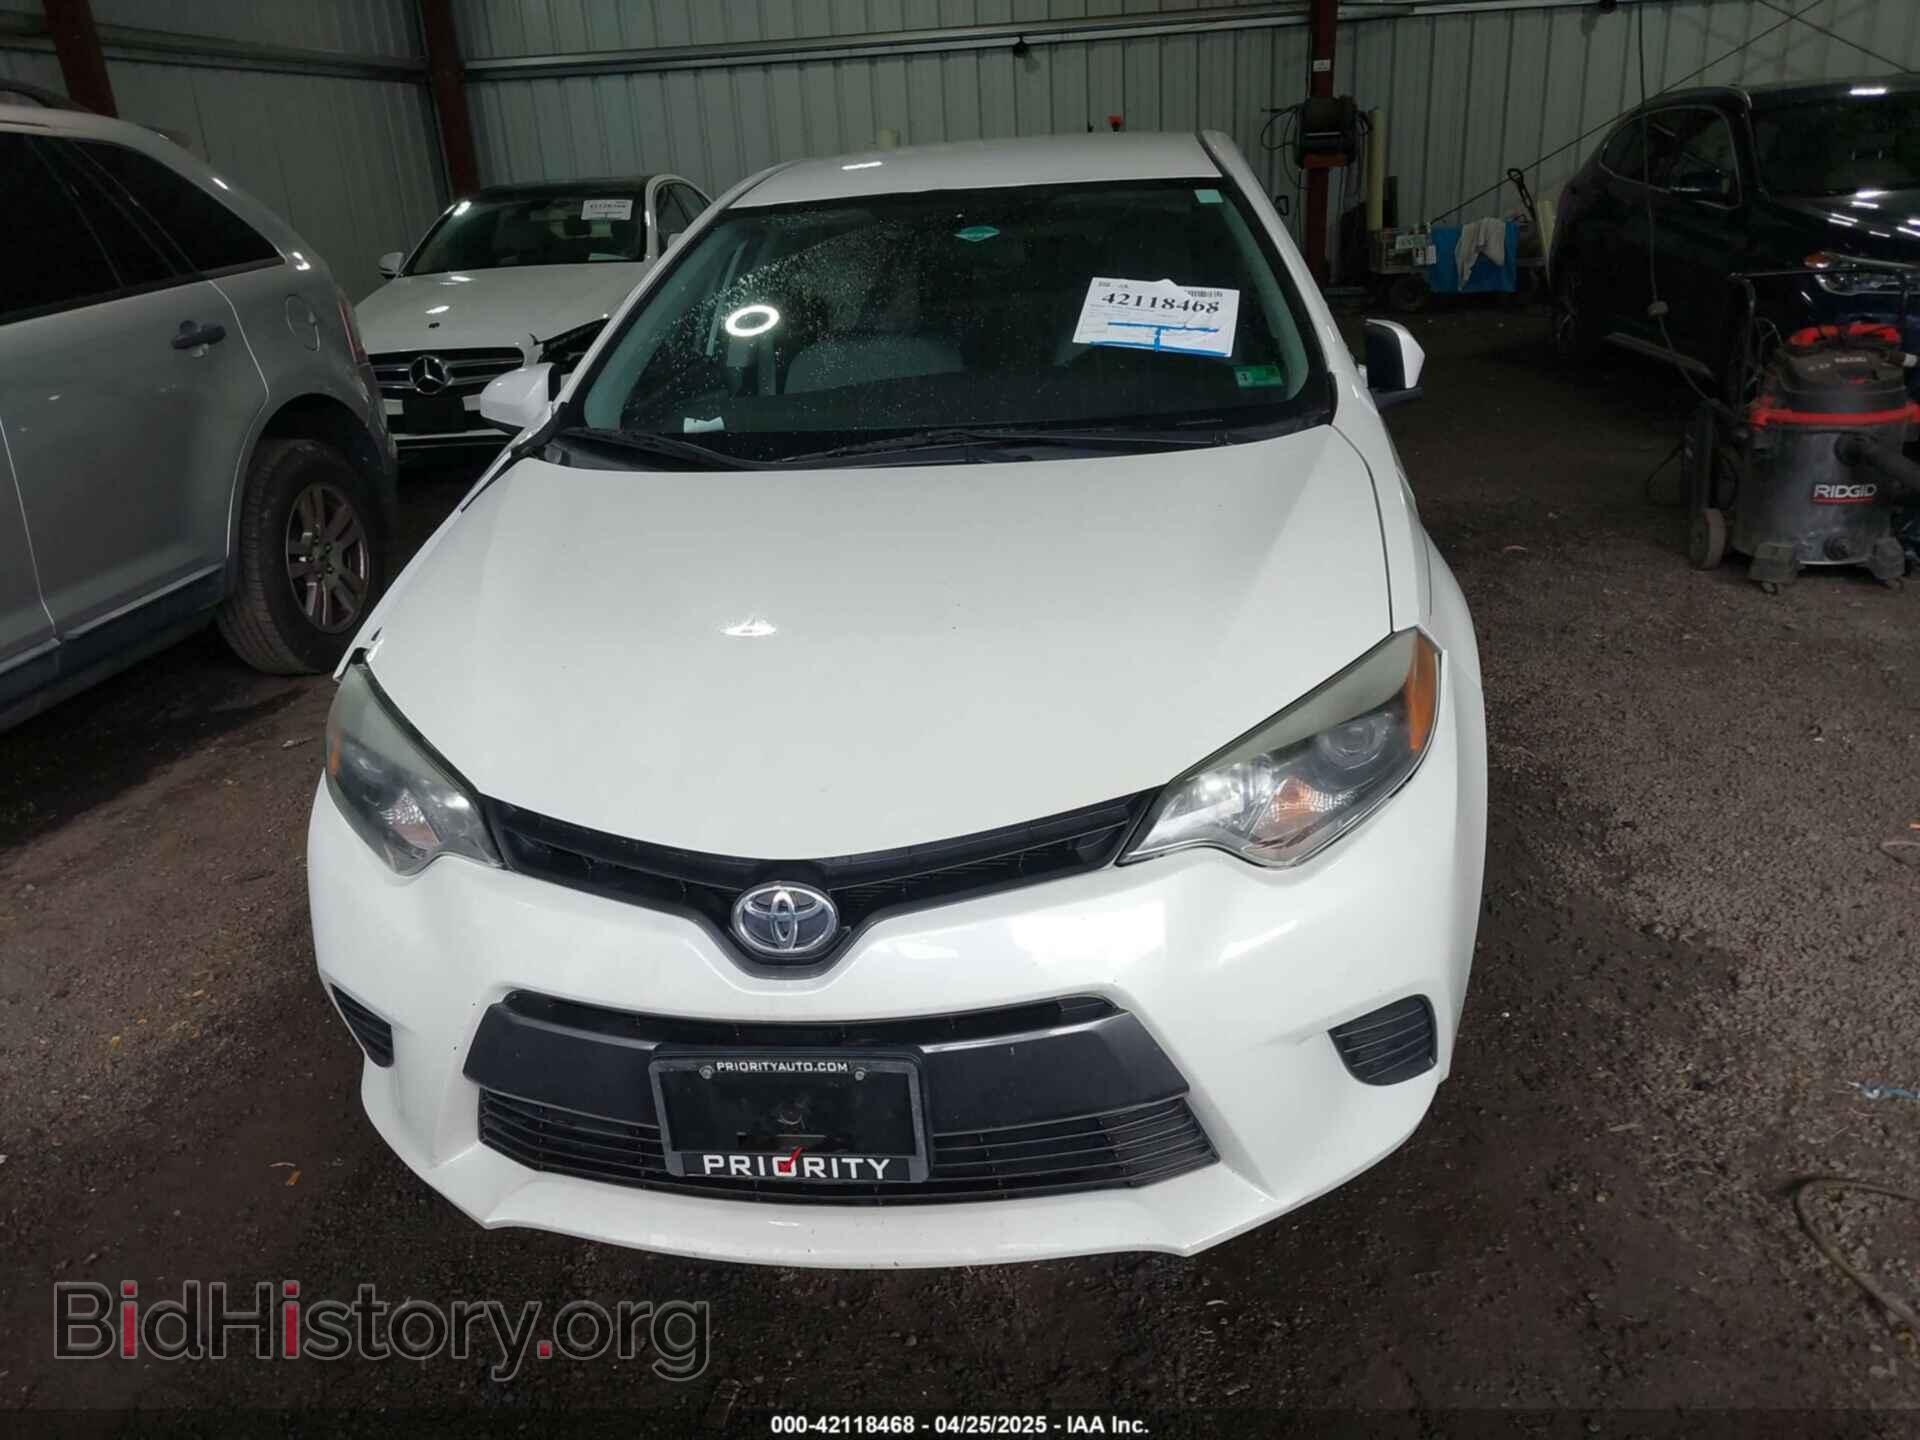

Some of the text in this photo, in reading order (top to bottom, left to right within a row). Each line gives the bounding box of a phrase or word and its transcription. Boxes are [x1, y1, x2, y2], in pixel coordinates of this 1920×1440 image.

[1101, 292, 1220, 314] 42118468
[1814, 483, 1877, 498] RIDGID
[716, 1061, 848, 1073] PRIORITYAUTO.COM
[703, 1151, 889, 1179] PRIORITY
